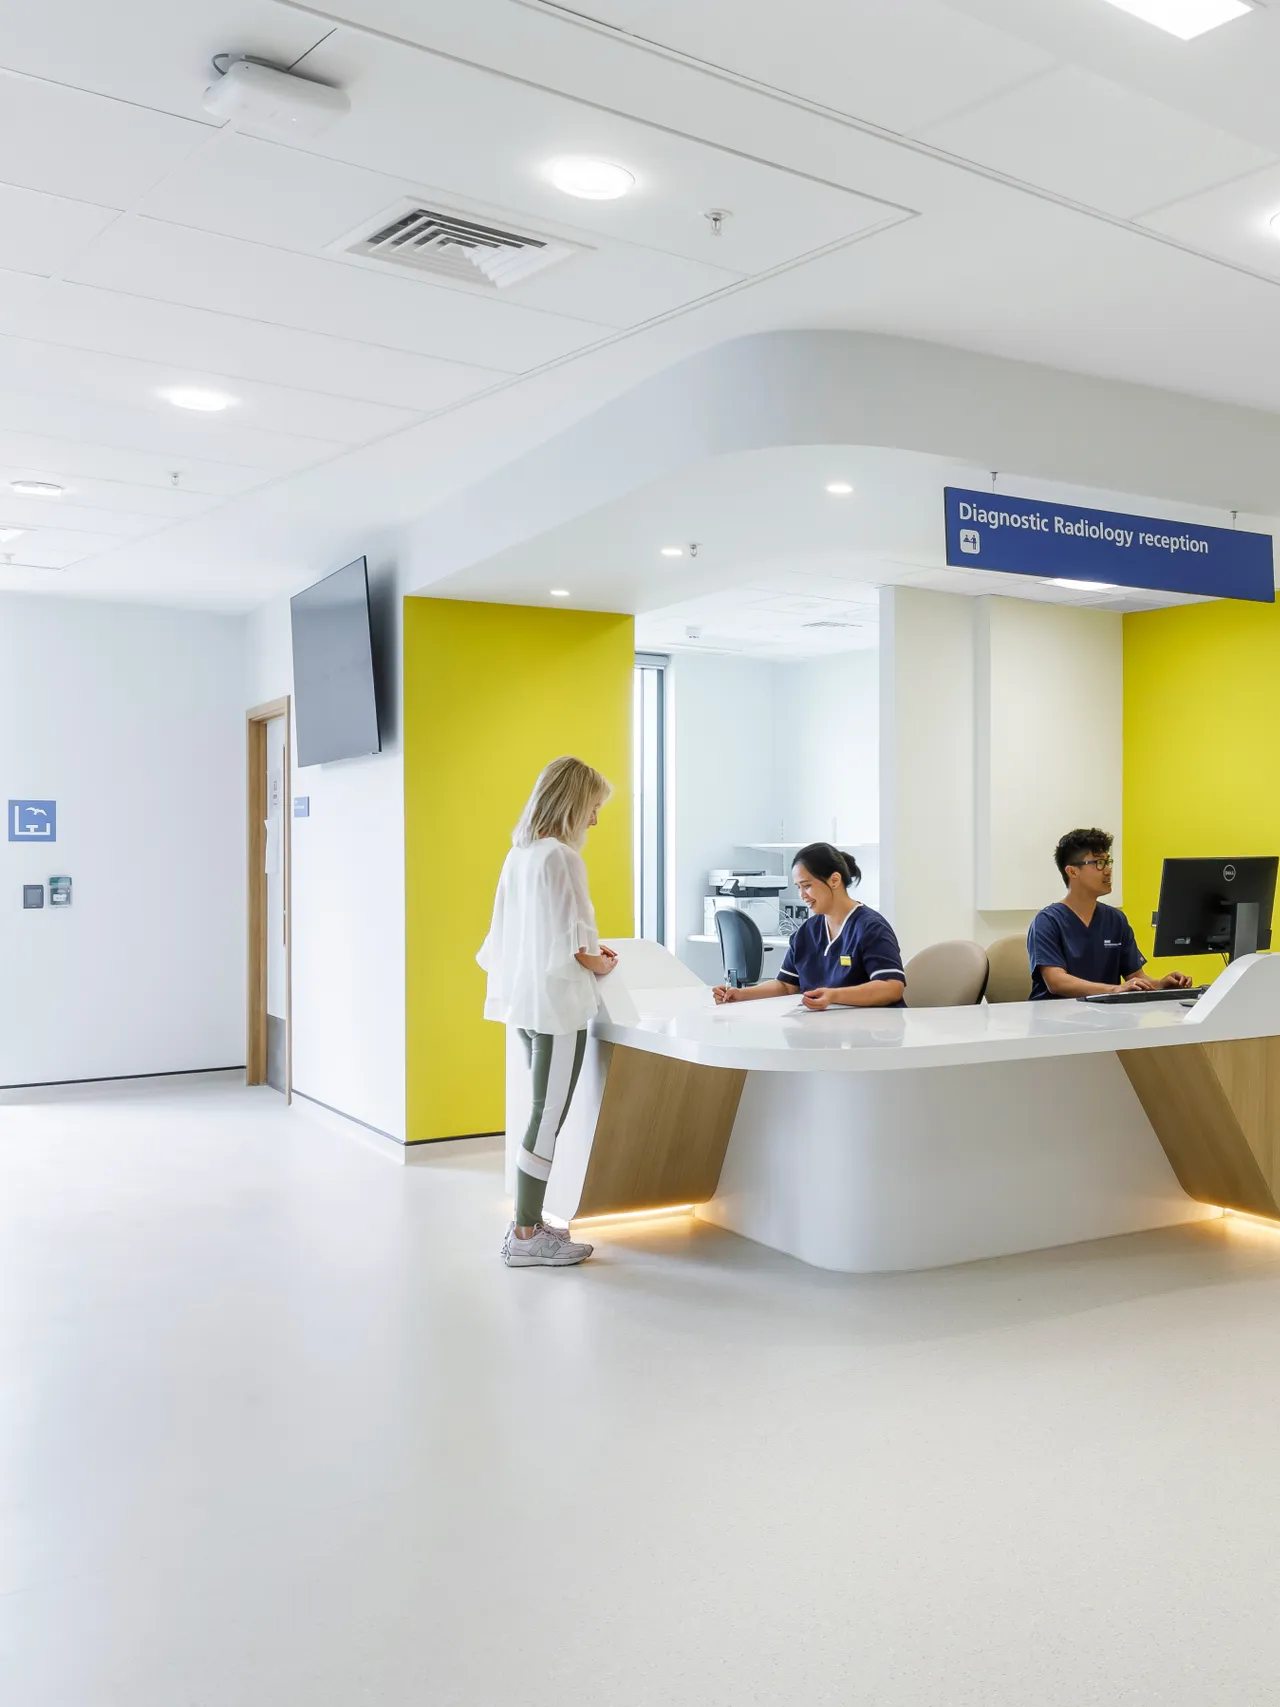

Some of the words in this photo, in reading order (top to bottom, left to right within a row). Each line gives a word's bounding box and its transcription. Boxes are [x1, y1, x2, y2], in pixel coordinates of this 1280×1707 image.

[959, 502, 1049, 531] Diagnostic
[1054, 516, 1134, 547] Radiology
[1139, 532, 1209, 554] reception
